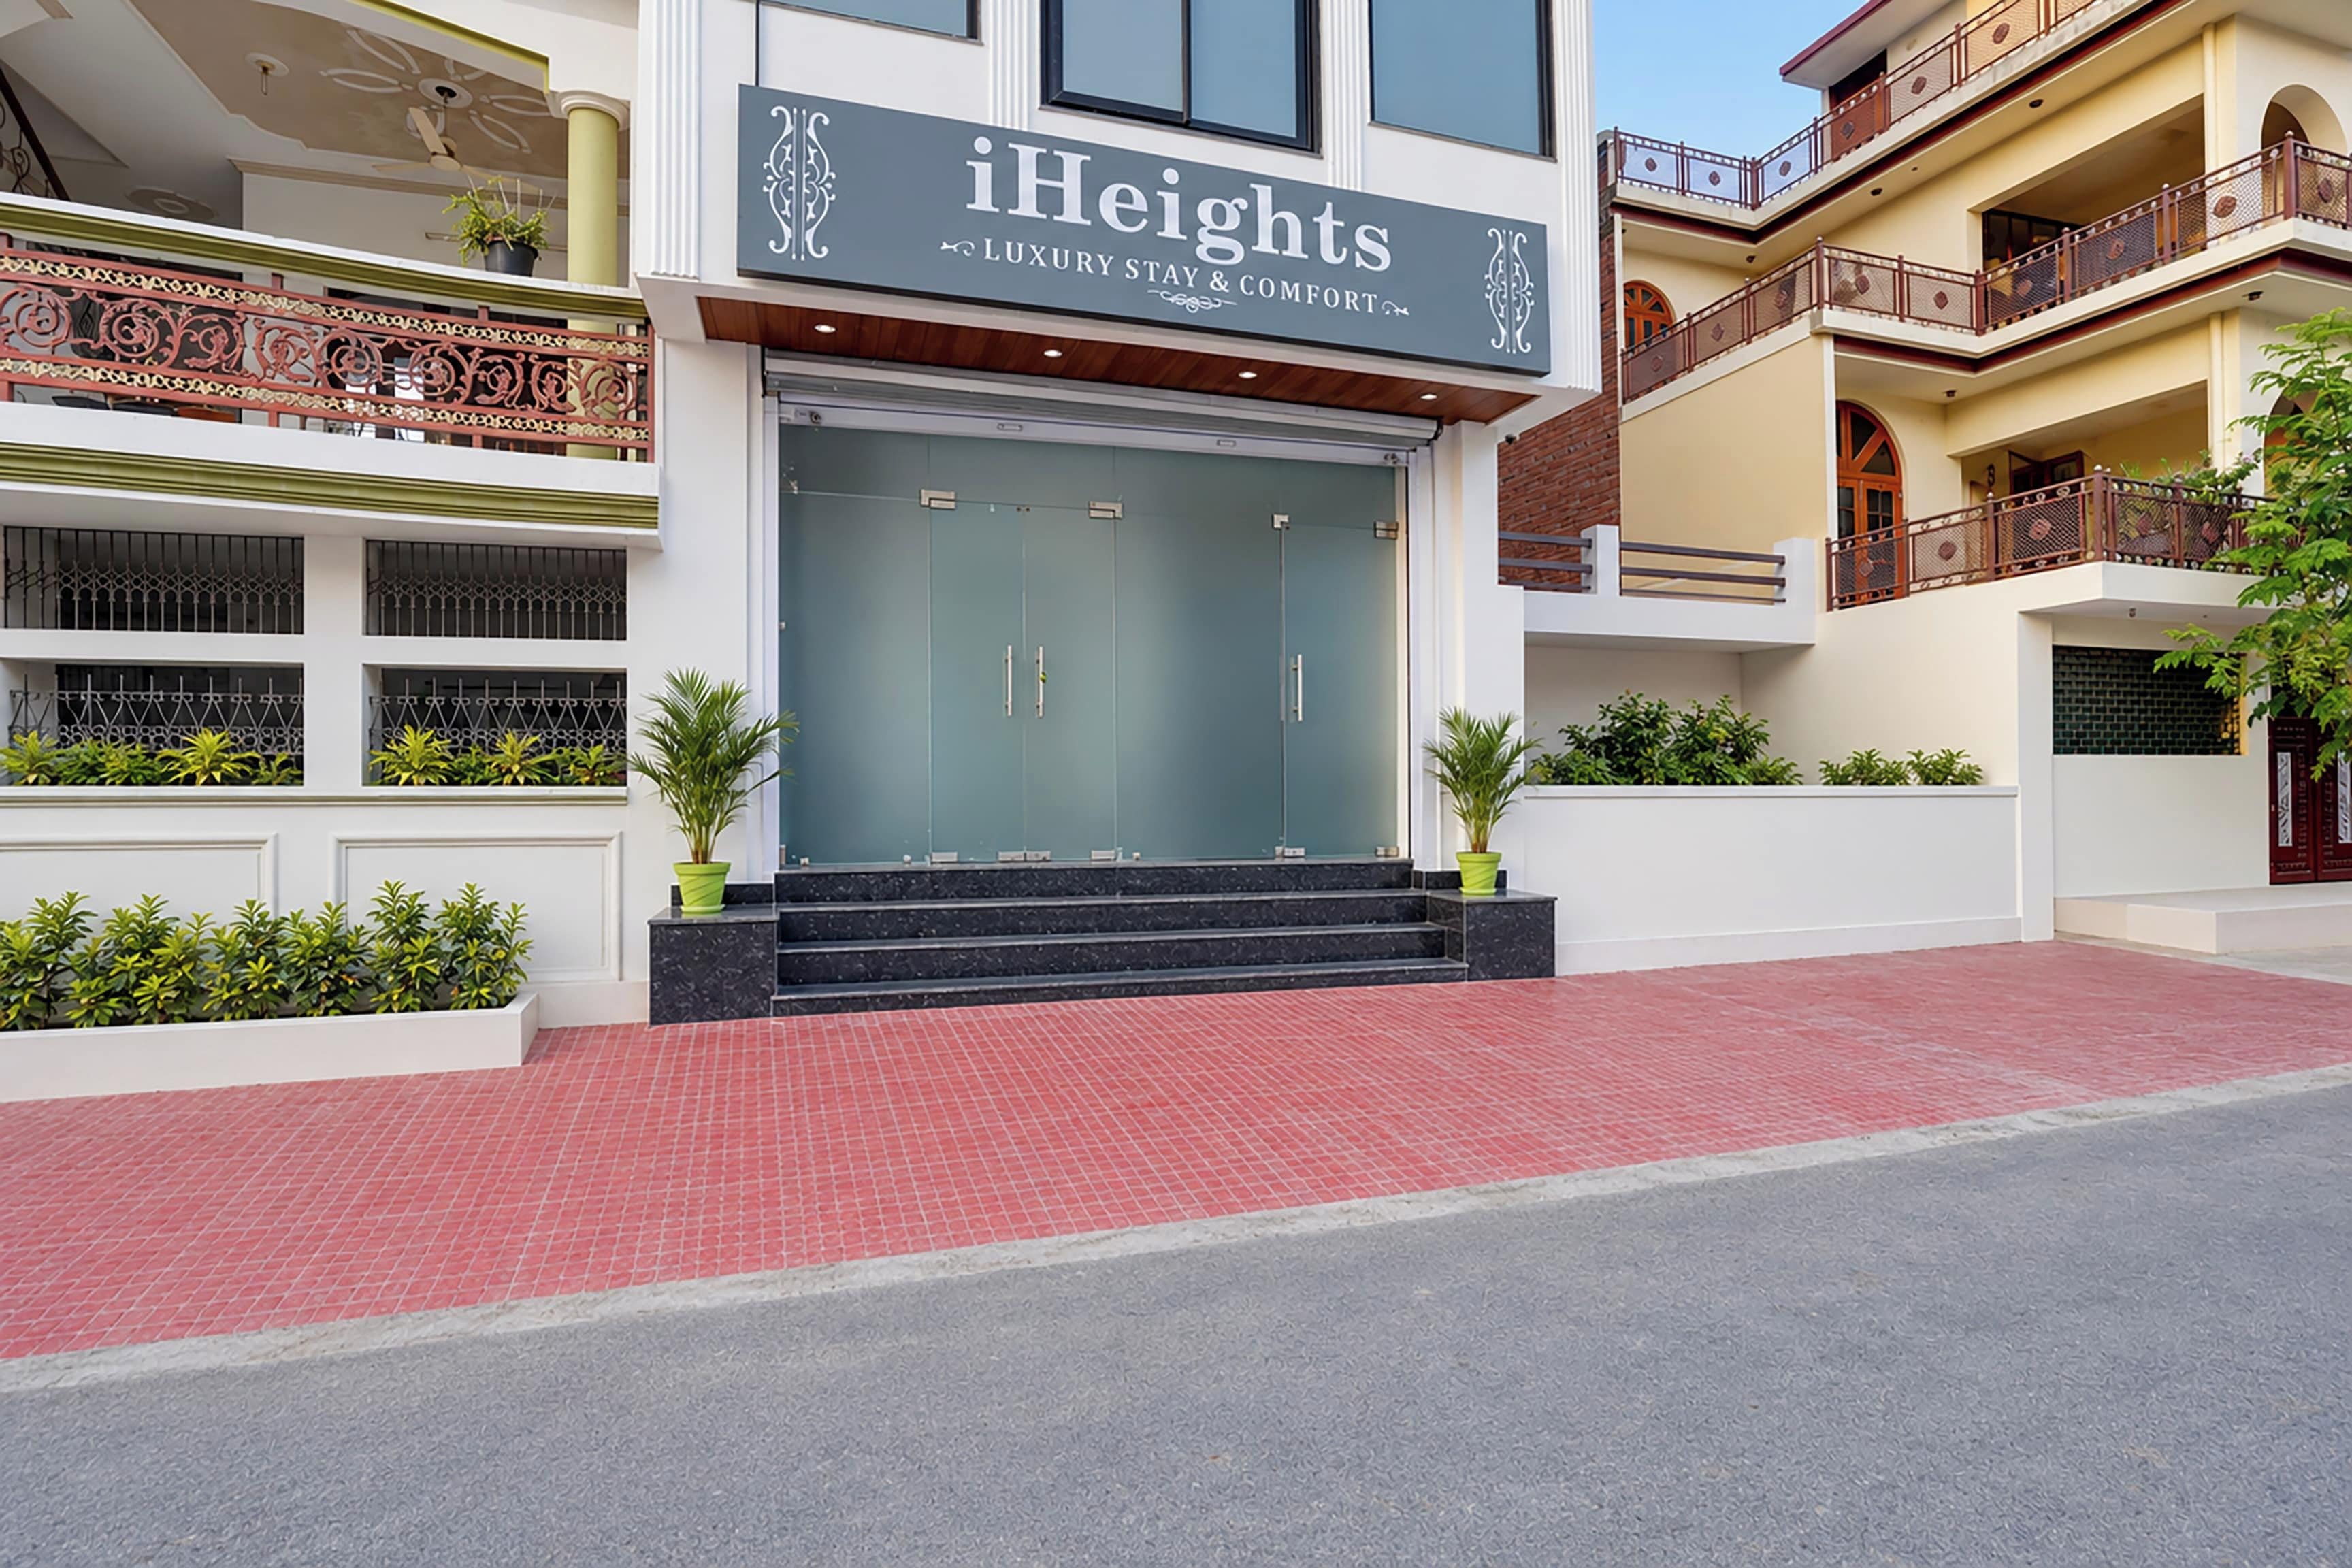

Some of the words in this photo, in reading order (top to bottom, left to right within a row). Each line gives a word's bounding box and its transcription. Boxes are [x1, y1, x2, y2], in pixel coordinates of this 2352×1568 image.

[965, 136, 1392, 272] iHeights
[984, 237, 1113, 277] LUXURY
[1124, 257, 1199, 289] STAY
[1209, 270, 1230, 293] &
[1240, 274, 1379, 314] COMFORT
